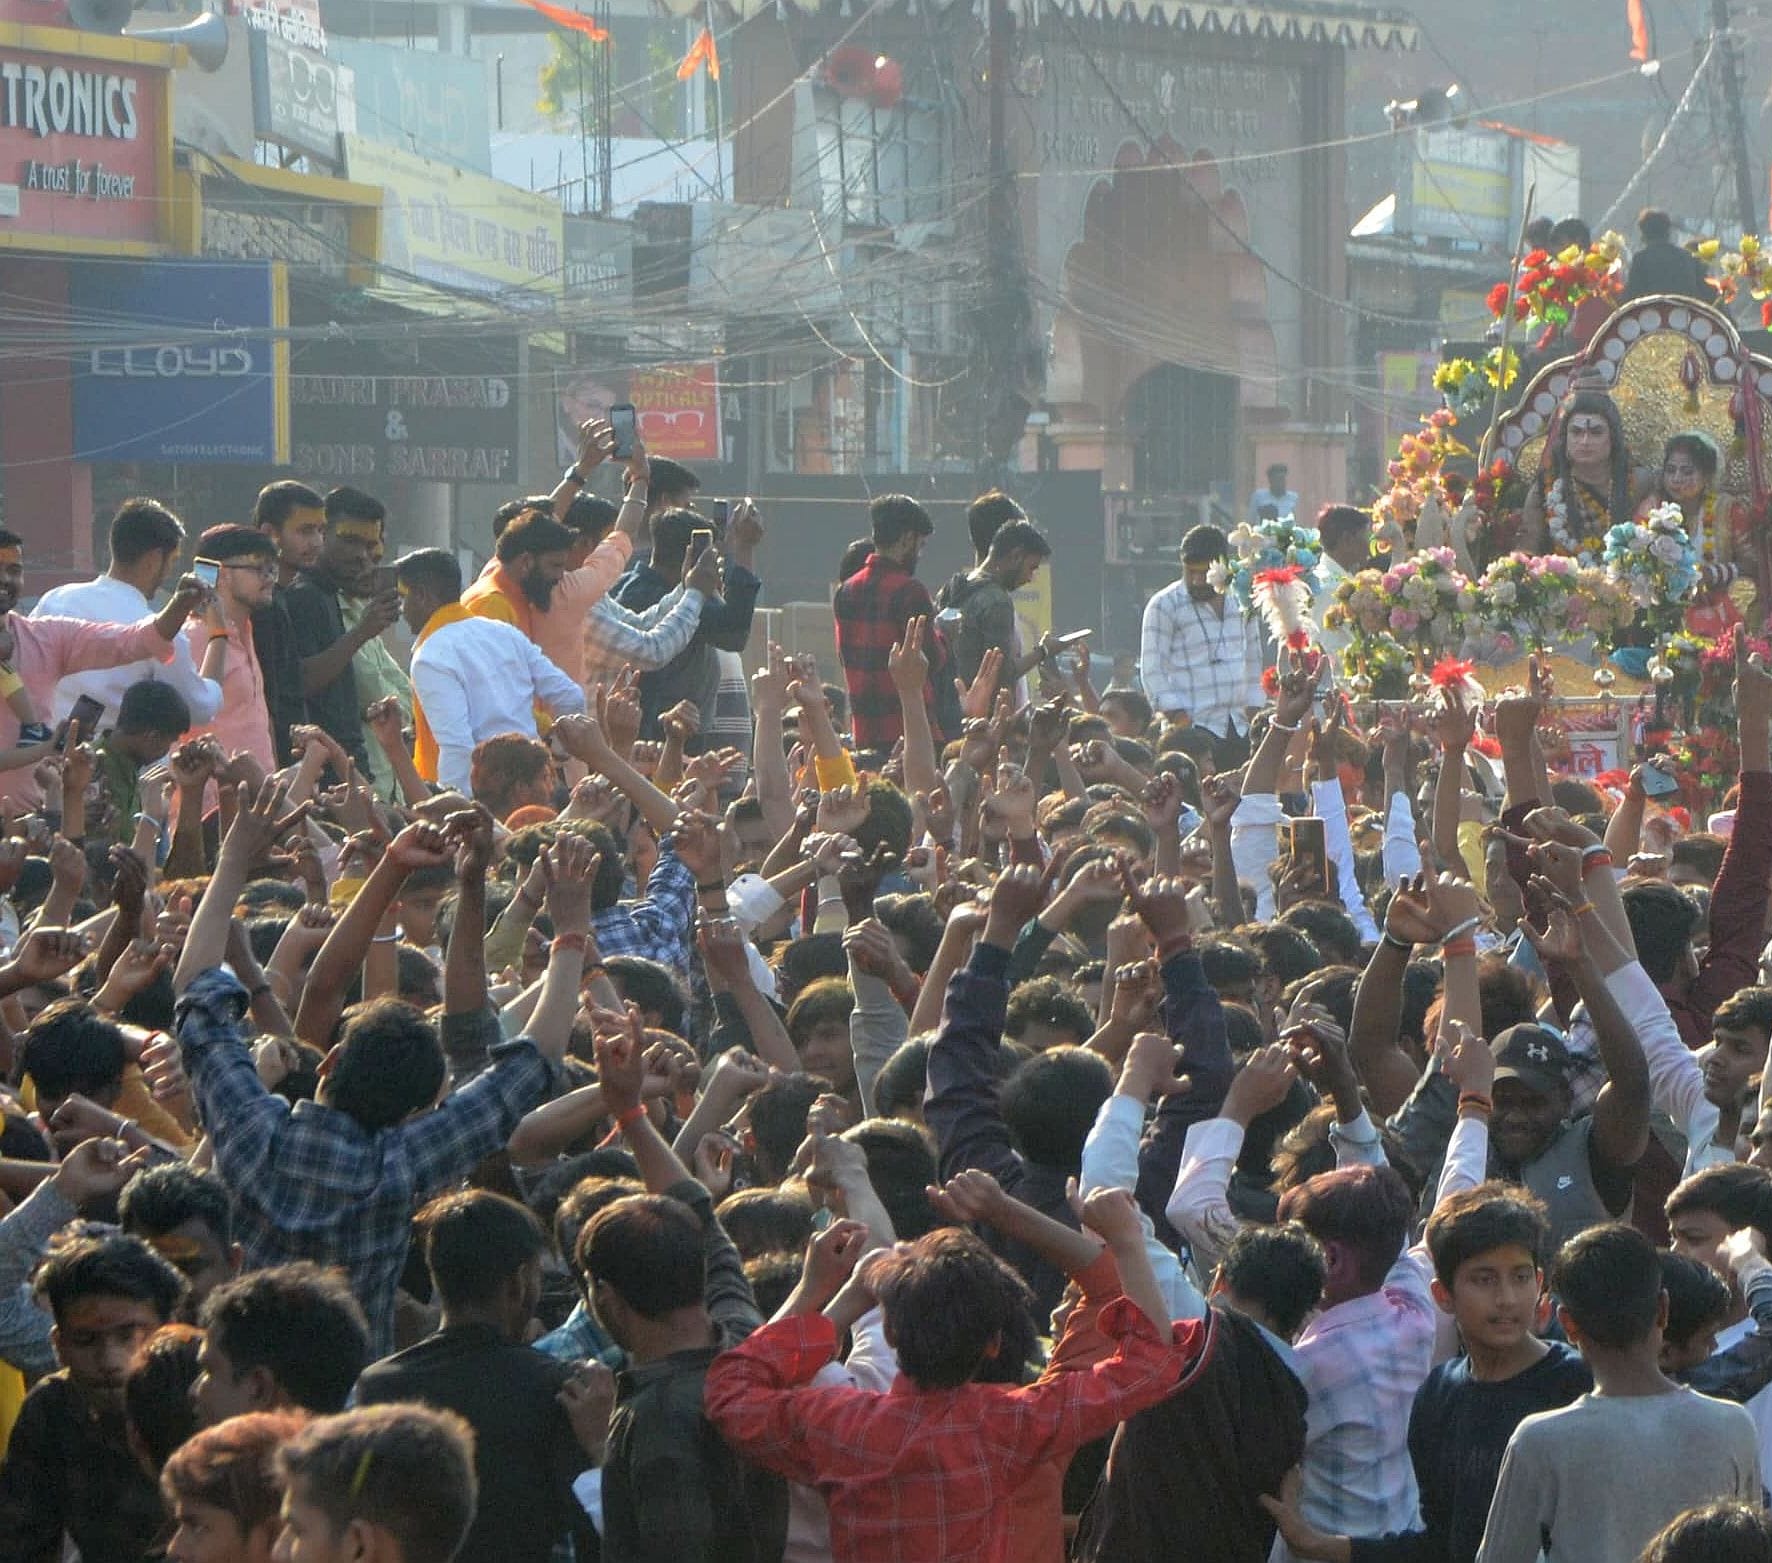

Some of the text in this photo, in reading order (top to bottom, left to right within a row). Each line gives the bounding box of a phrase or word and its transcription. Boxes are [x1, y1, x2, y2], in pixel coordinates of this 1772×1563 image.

[2, 62, 137, 139] TRONICS
[28, 158, 136, 202] A trust for forever
[91, 346, 251, 377] LLOYD
[384, 409, 409, 440] &
[299, 443, 376, 474] SONS
